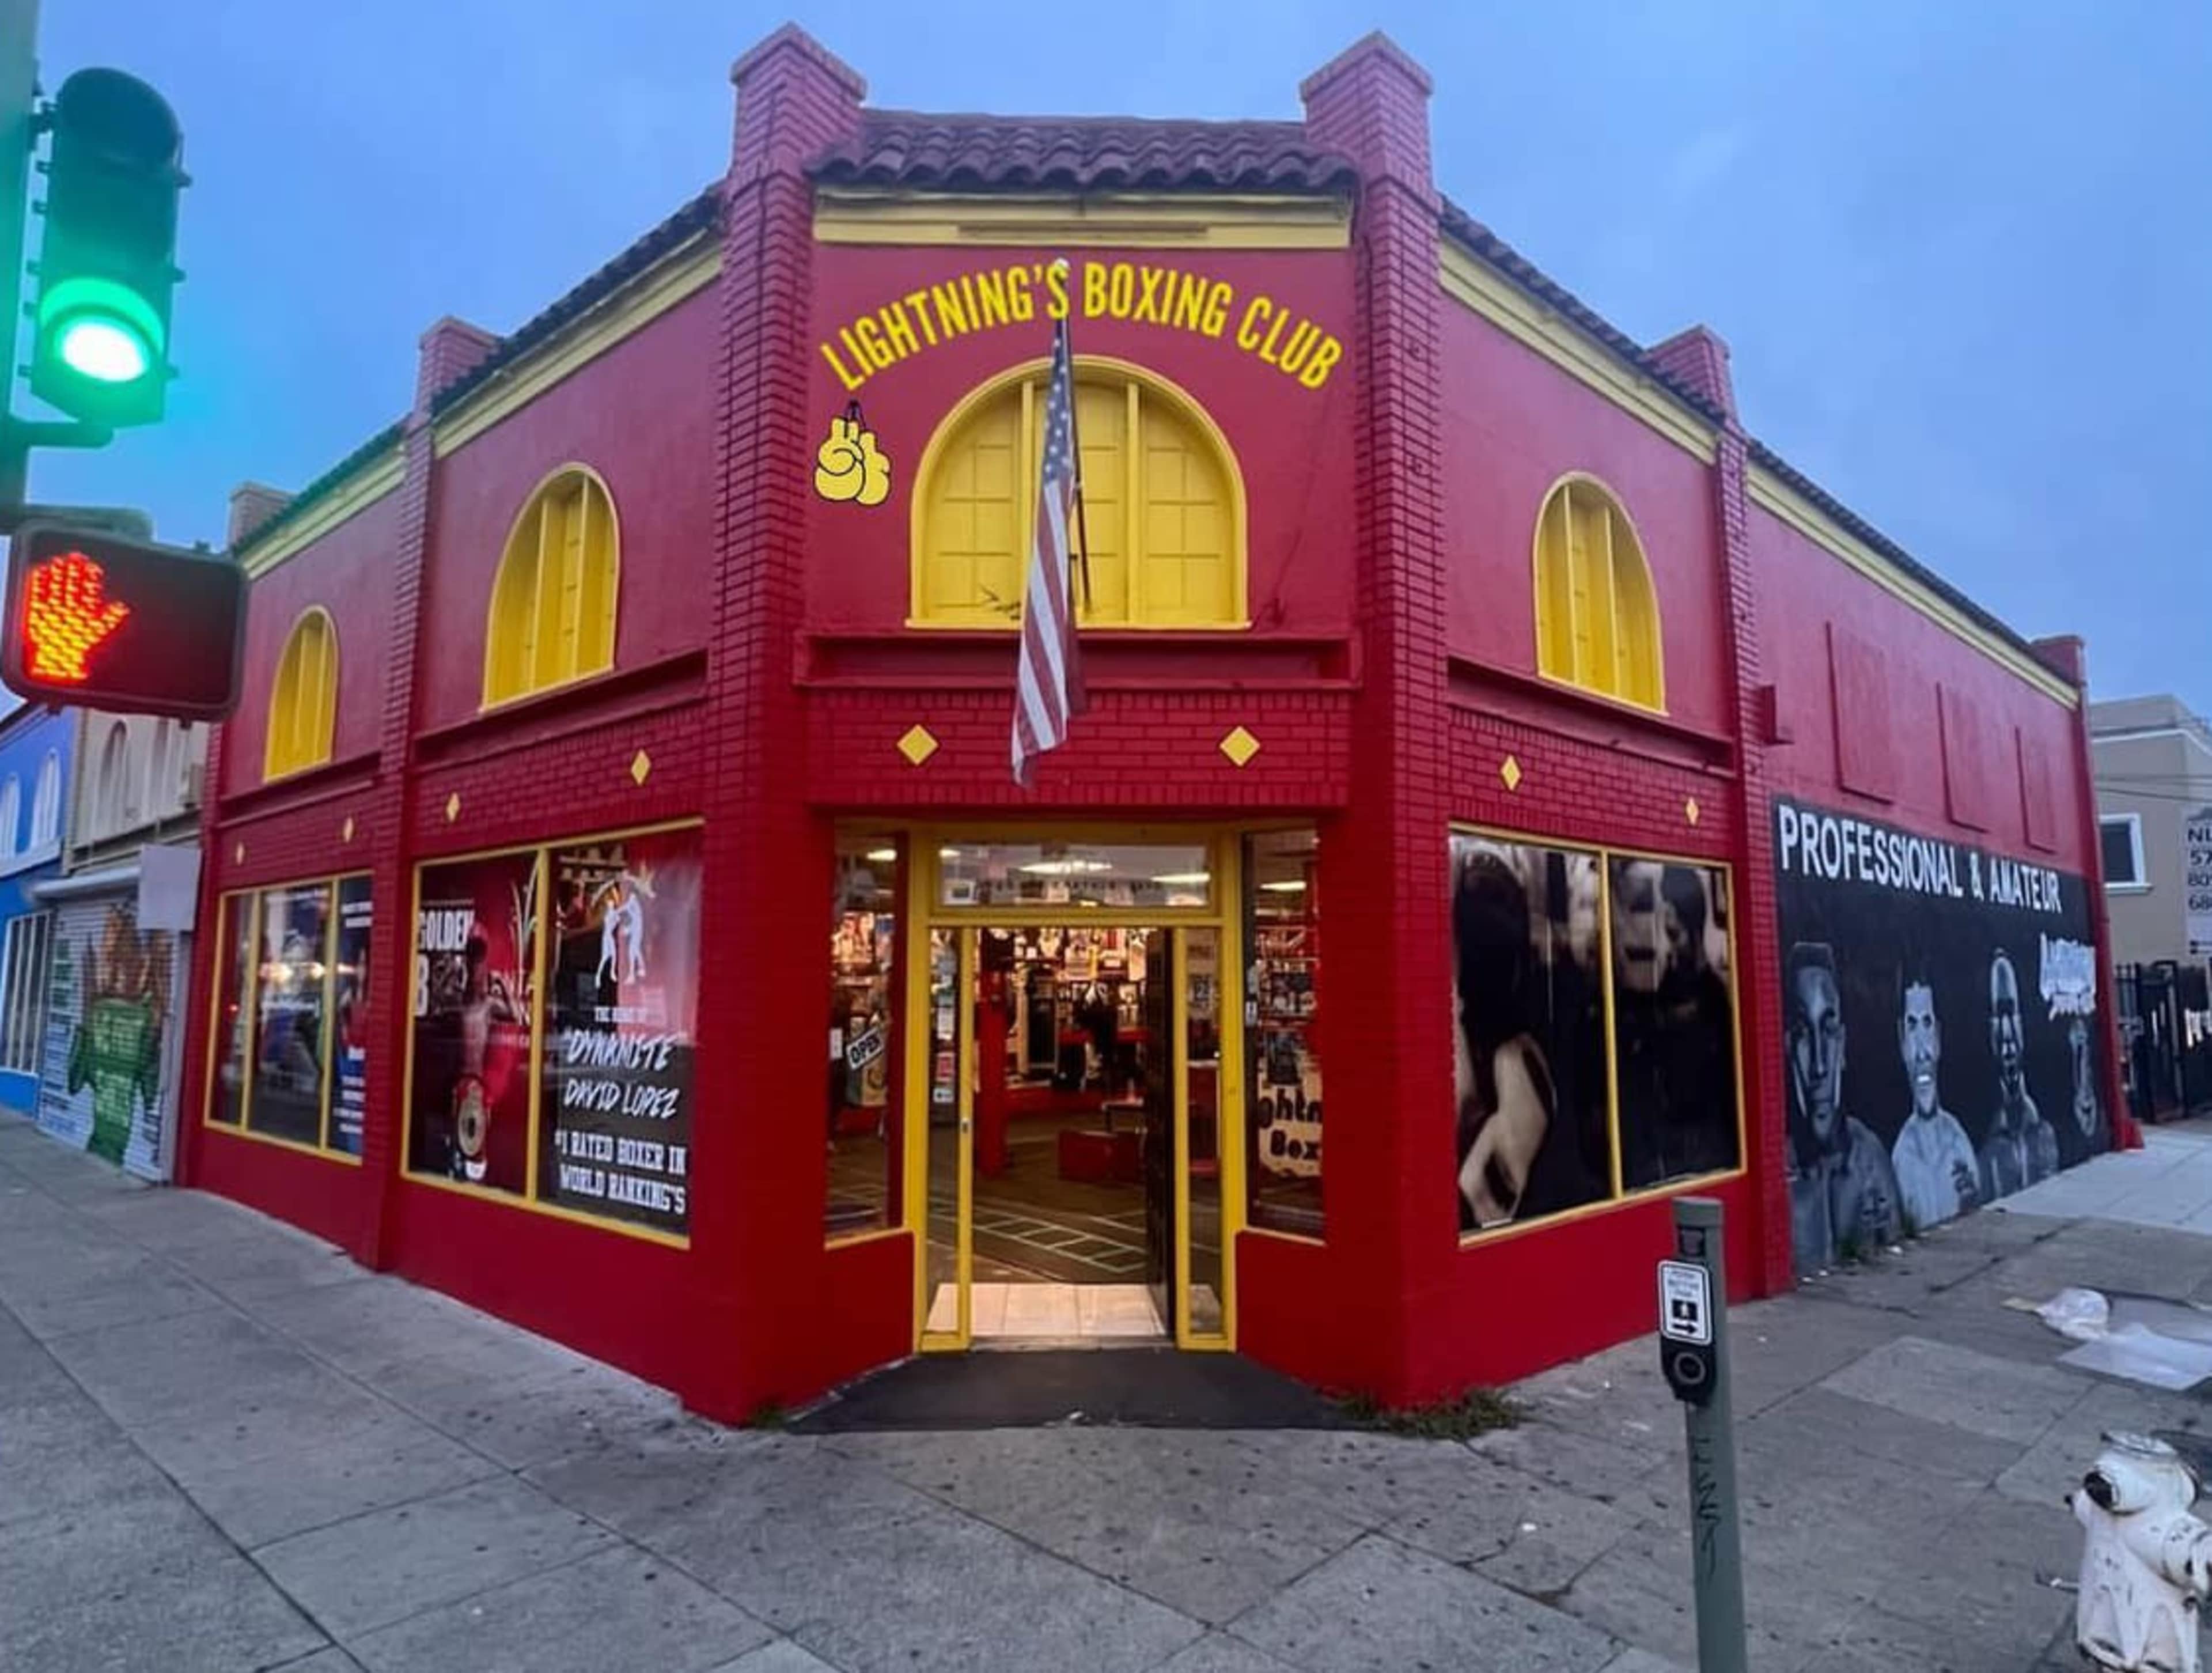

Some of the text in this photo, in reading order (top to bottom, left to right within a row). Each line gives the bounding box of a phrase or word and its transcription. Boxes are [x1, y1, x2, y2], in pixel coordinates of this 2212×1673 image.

[821, 262, 1343, 391] LIGHTNING'S BOXING CLUB
[1779, 805, 2062, 914] PROFESSIONAL & AMATEUR
[850, 1034, 880, 1064] OPEN
[563, 1077, 680, 1119] DAVID LOPEZ
[571, 1130, 613, 1162] RATED
[617, 1136, 664, 1171] BOXER
[668, 1144, 686, 1175] IN
[560, 1163, 685, 1215] WORLD RANKING'S
